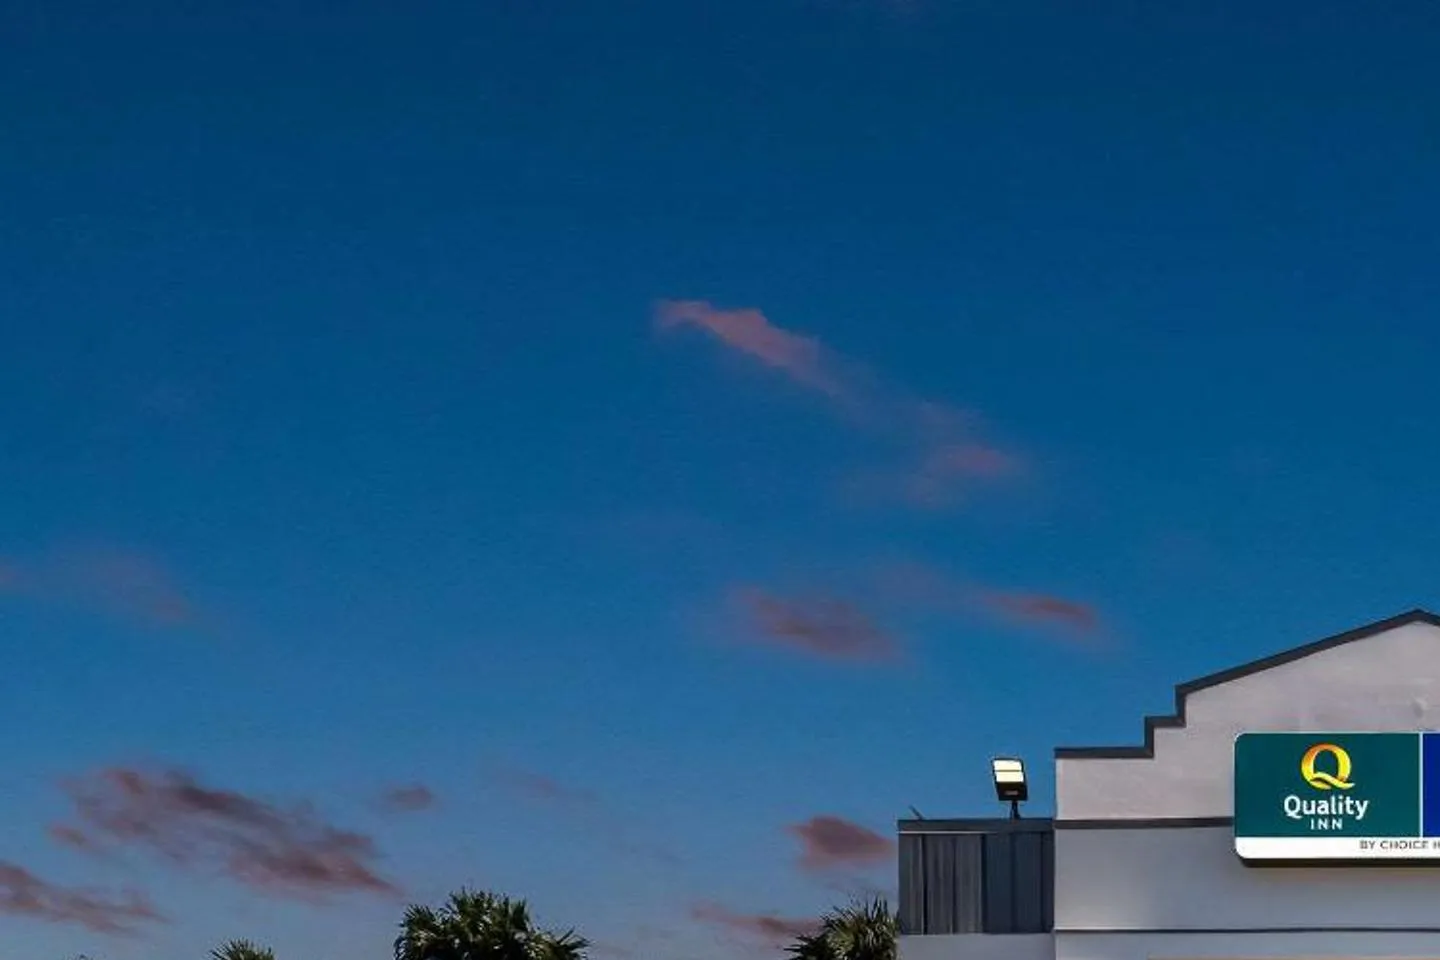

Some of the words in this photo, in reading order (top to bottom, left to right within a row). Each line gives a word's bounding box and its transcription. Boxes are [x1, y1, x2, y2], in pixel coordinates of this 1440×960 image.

[1300, 742, 1355, 790] Q
[1283, 795, 1369, 820] Quality
[1310, 818, 1343, 831] INN
[1359, 839, 1376, 850] BY
[1379, 839, 1429, 850] CHOICE
